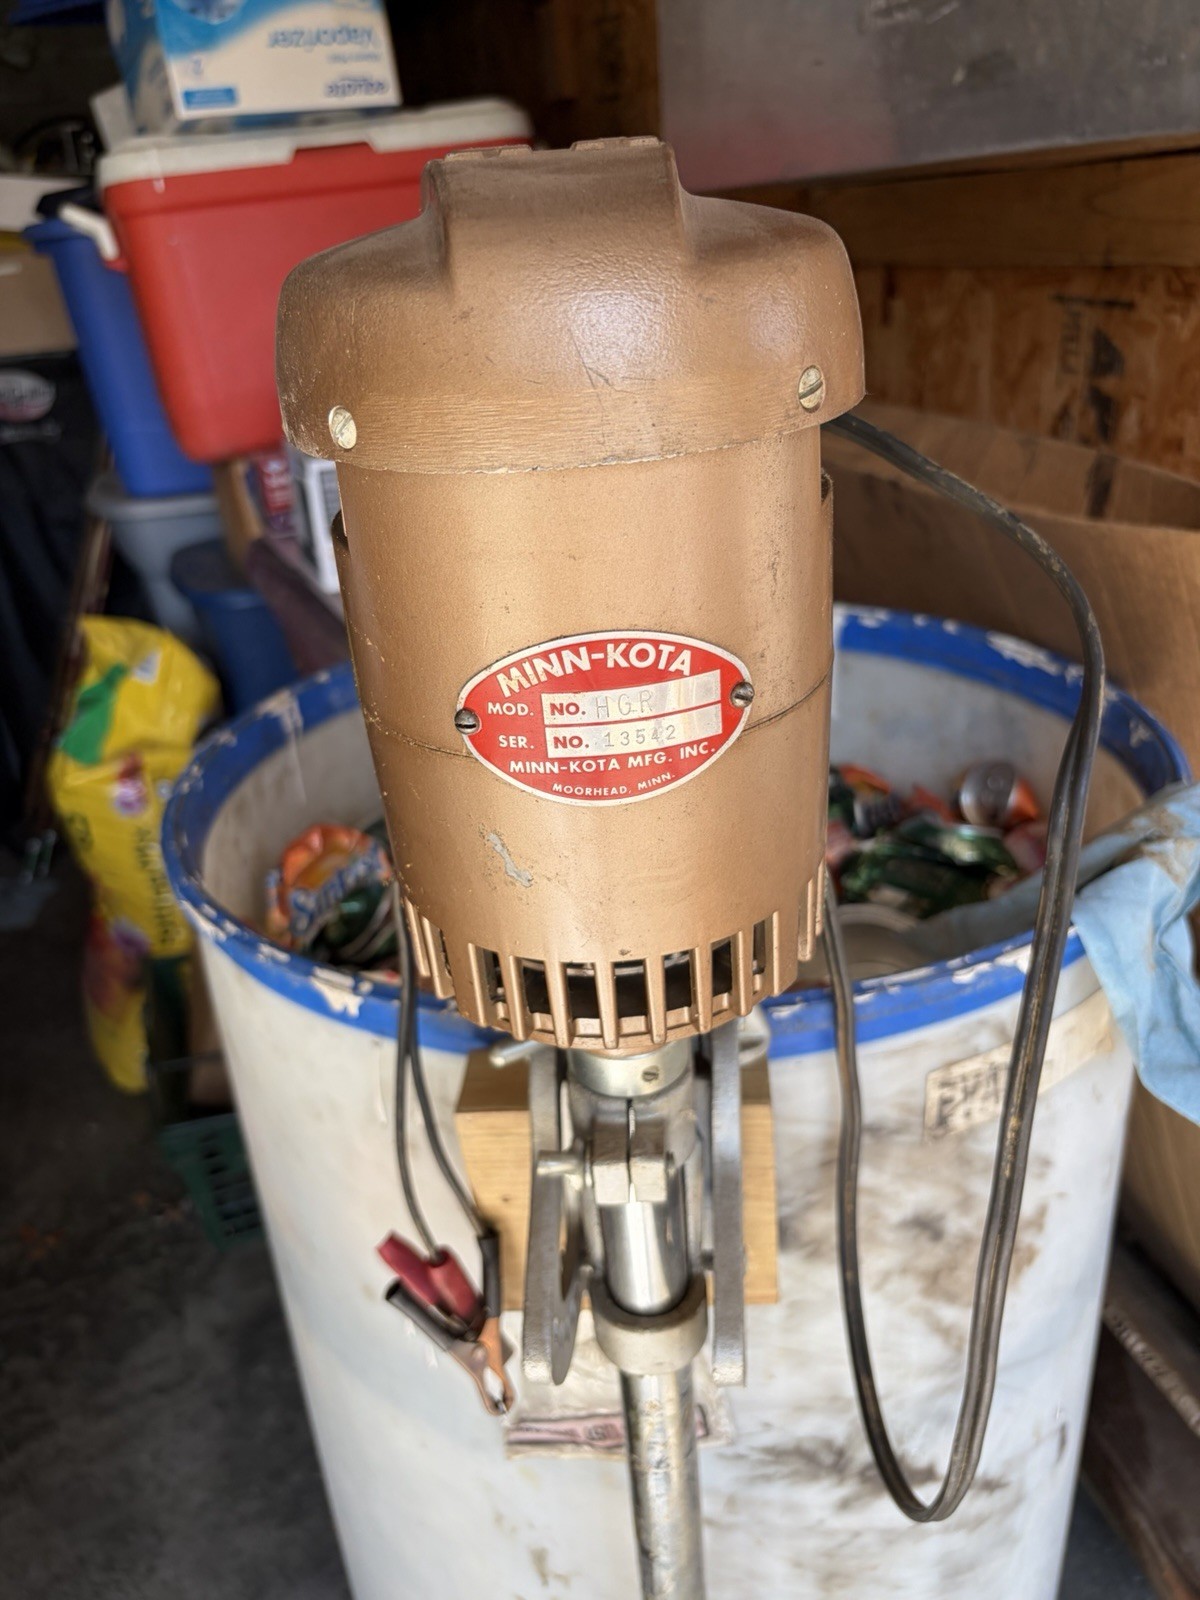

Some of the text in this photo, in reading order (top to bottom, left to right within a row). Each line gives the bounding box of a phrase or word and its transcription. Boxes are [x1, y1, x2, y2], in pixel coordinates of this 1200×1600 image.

[495, 642, 692, 698] MINN-KOTA
[487, 701, 534, 716] MOD.
[550, 702, 586, 716] NO.
[498, 724, 676, 749] SER. NO. 13542
[509, 741, 716, 774] MINN-KOTA MFG. INC.
[552, 772, 676, 796] MOORHEAD, MINN.
